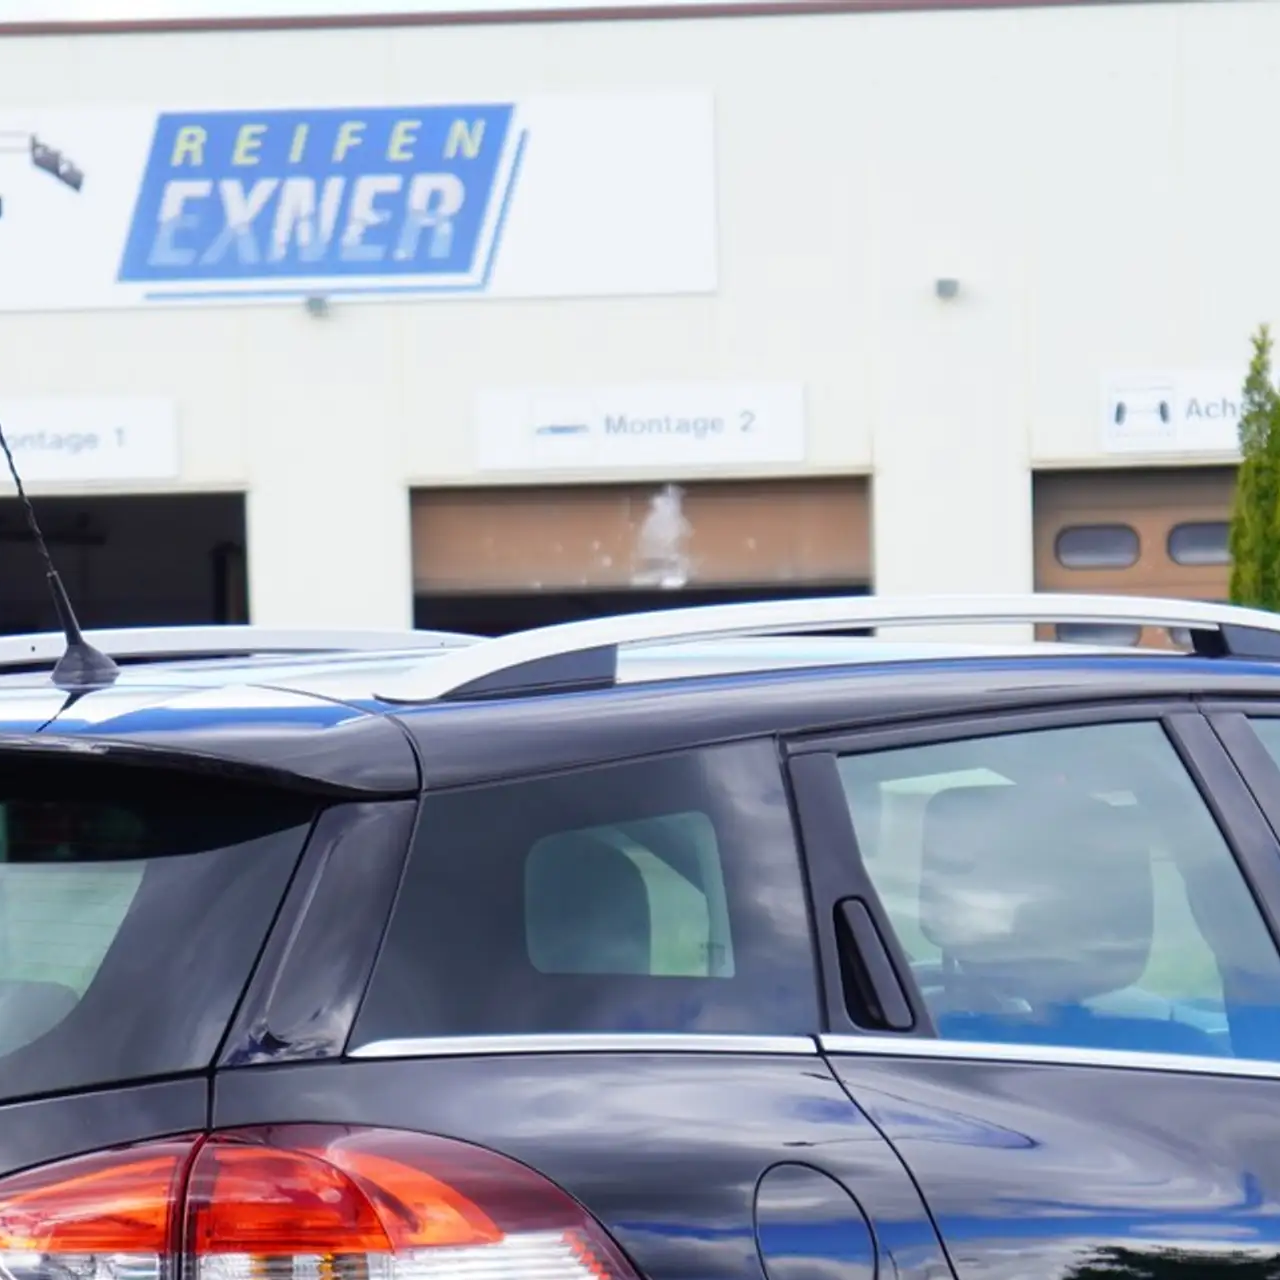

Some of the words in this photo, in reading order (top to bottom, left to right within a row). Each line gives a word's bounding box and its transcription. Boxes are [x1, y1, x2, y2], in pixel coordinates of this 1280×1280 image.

[171, 118, 487, 167] REIFEN
[146, 172, 466, 267] EXNER
[604, 412, 725, 440] Montage
[739, 410, 757, 433] 2
